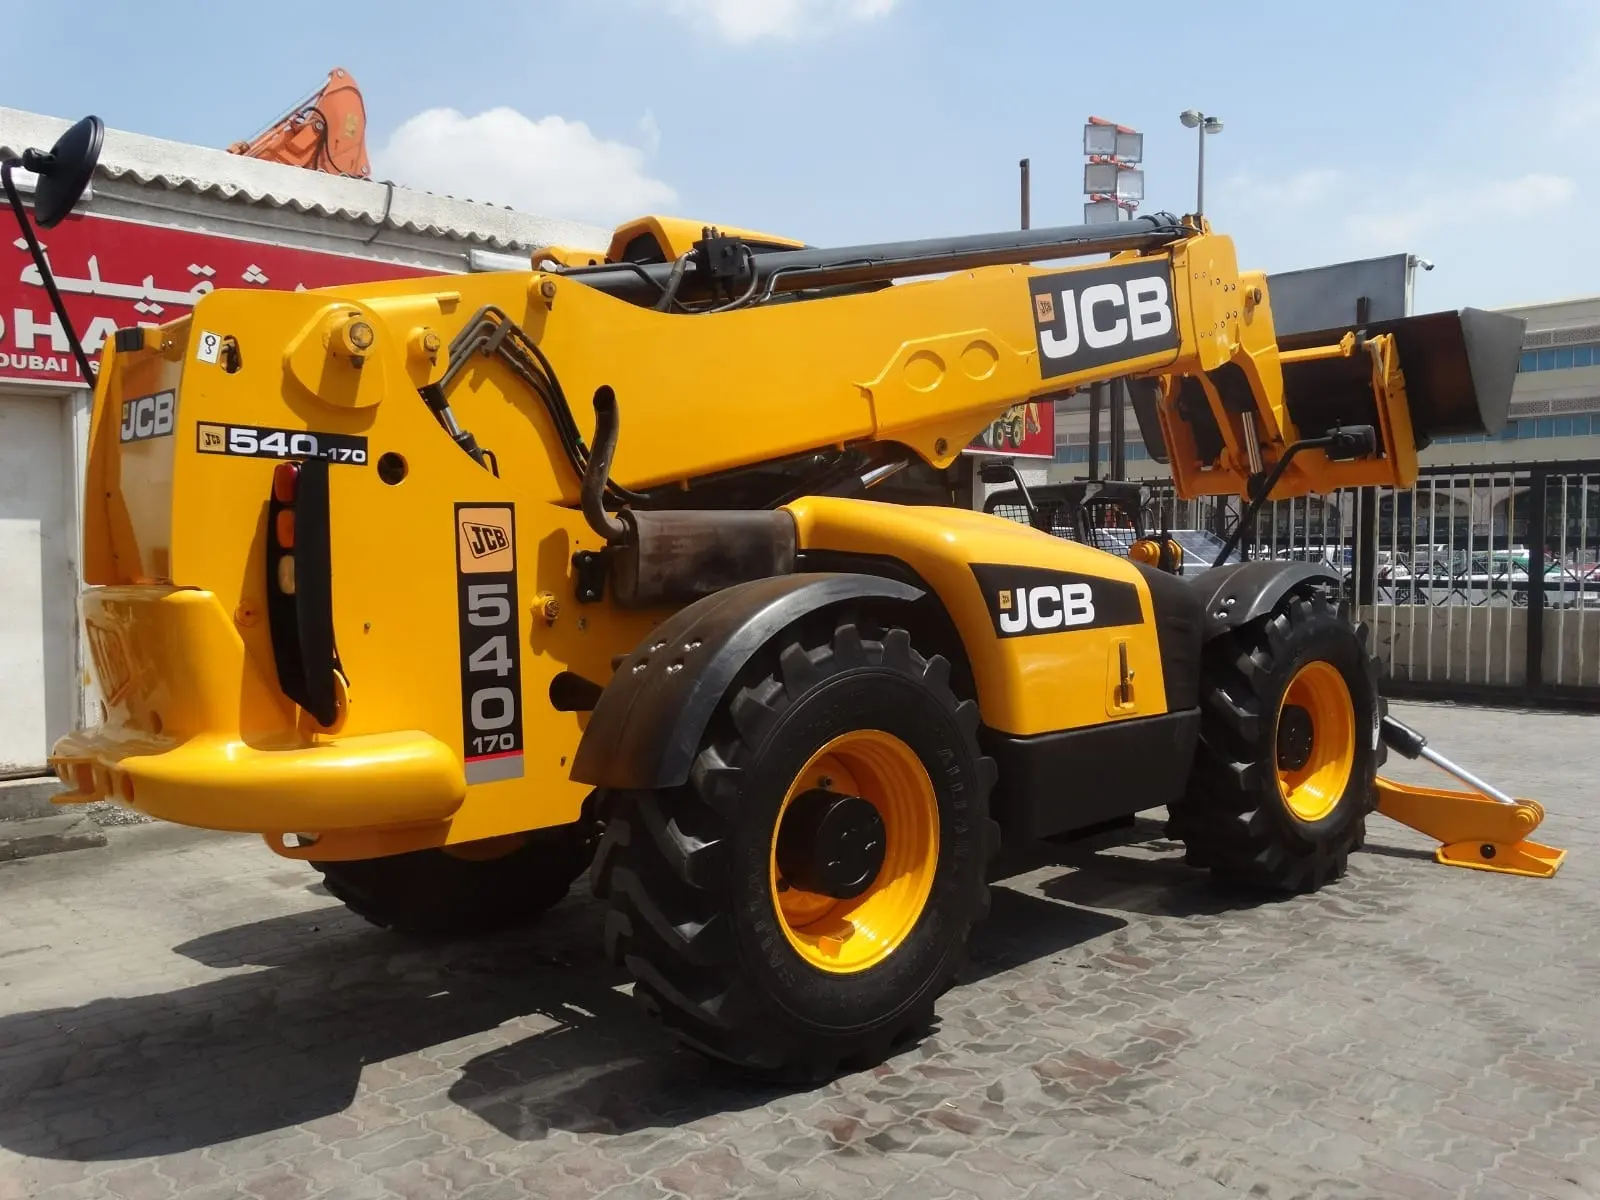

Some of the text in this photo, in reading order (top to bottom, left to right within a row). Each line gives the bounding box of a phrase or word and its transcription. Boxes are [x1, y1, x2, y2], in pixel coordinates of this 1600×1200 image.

[0, 308, 160, 355] HA
[1040, 276, 1172, 359] JCB
[121, 392, 174, 441] JCB
[205, 433, 220, 446] JCB
[471, 525, 508, 555] JCB
[1000, 583, 1095, 633] JCB
[467, 583, 515, 731] 540
[472, 733, 515, 753] 170
